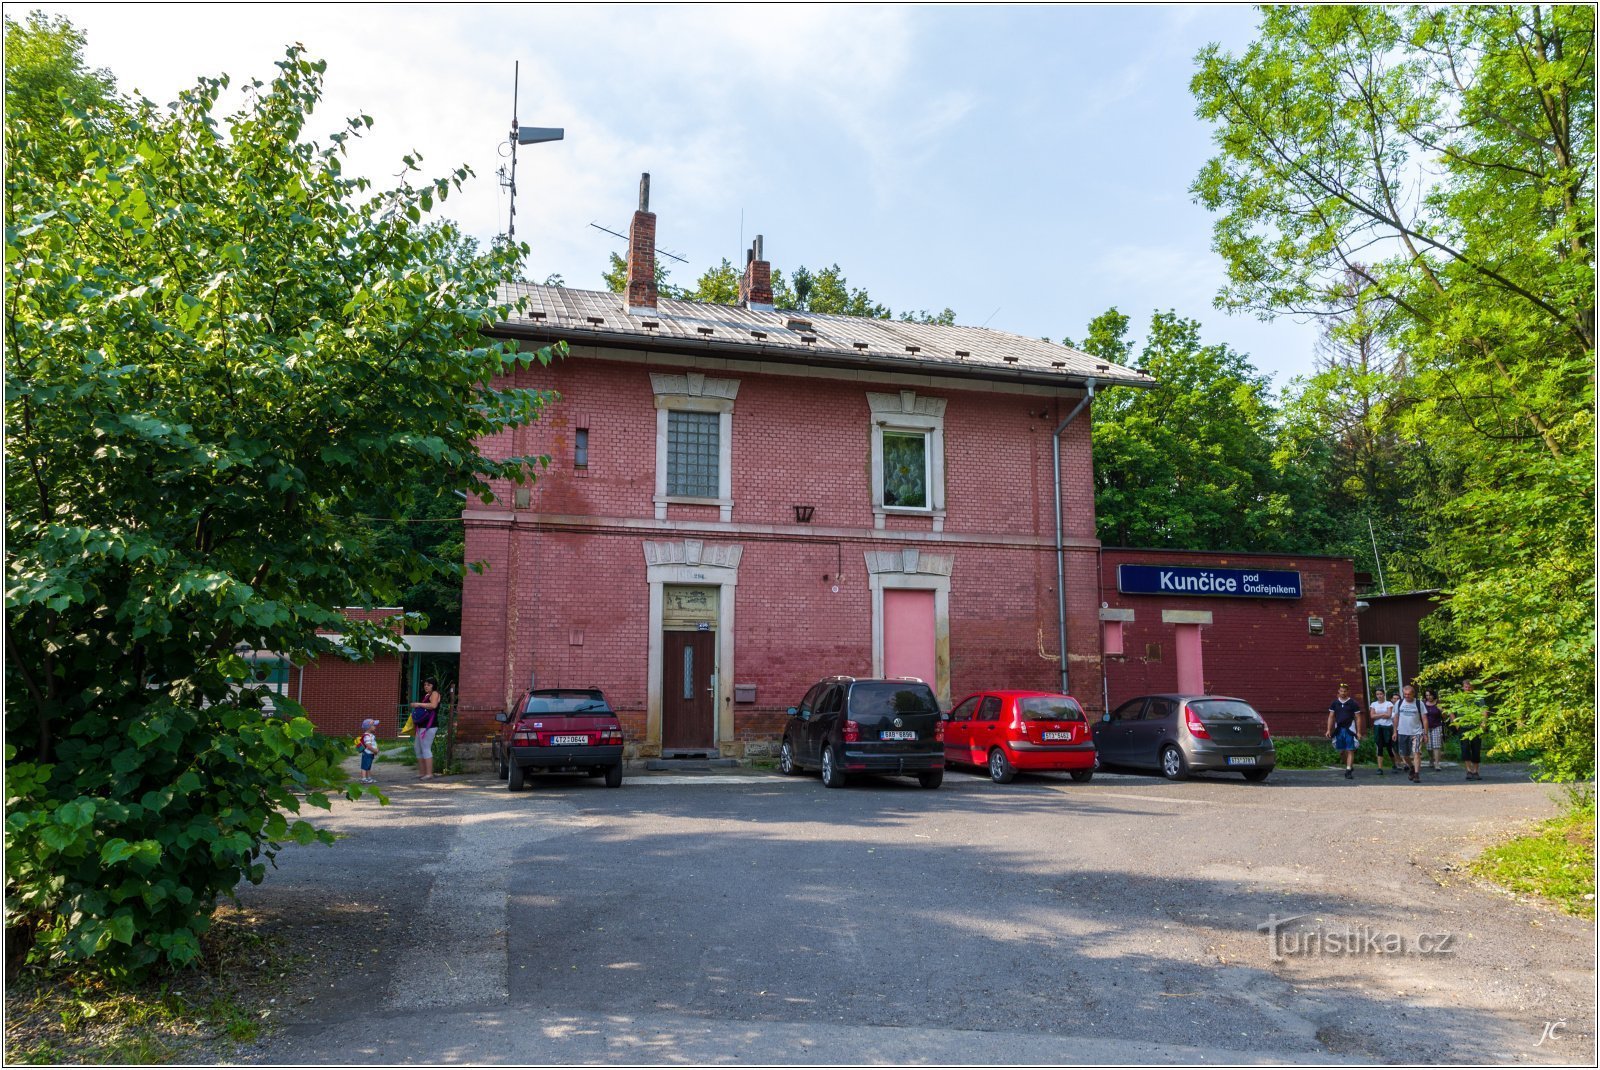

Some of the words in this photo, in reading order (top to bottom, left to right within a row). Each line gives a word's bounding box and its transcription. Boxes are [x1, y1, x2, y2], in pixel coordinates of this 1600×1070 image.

[1160, 571, 1237, 592] Kunčice
[1243, 573, 1259, 583] pod
[1243, 584, 1296, 595] Ondřejníkem
